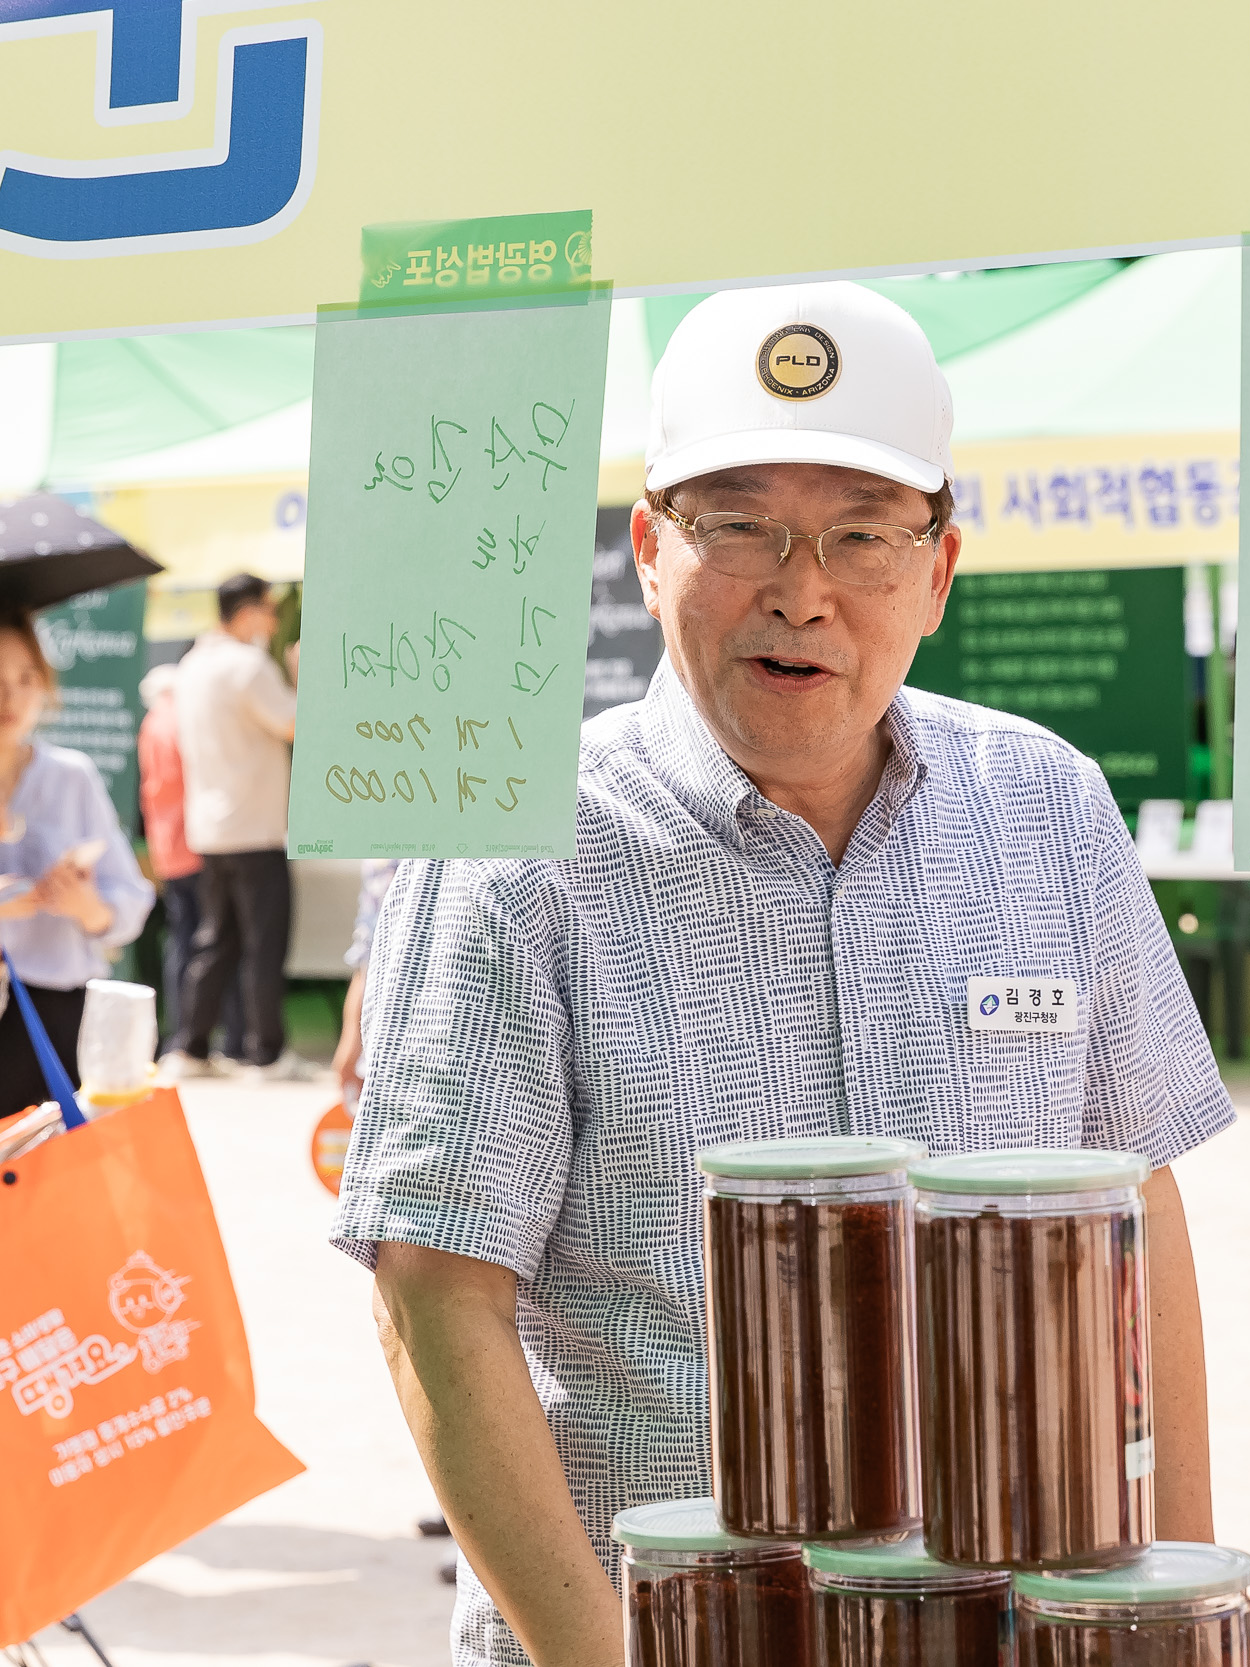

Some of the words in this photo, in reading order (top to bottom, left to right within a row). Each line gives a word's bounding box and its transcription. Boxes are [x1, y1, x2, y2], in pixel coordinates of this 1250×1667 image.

[814, 331, 836, 359] DESIGN
[775, 355, 821, 366] PLD
[761, 366, 793, 396] PHOENIX
[801, 367, 835, 396] ARIZONA
[1014, 1011, 1058, 1024] 광진구청장
